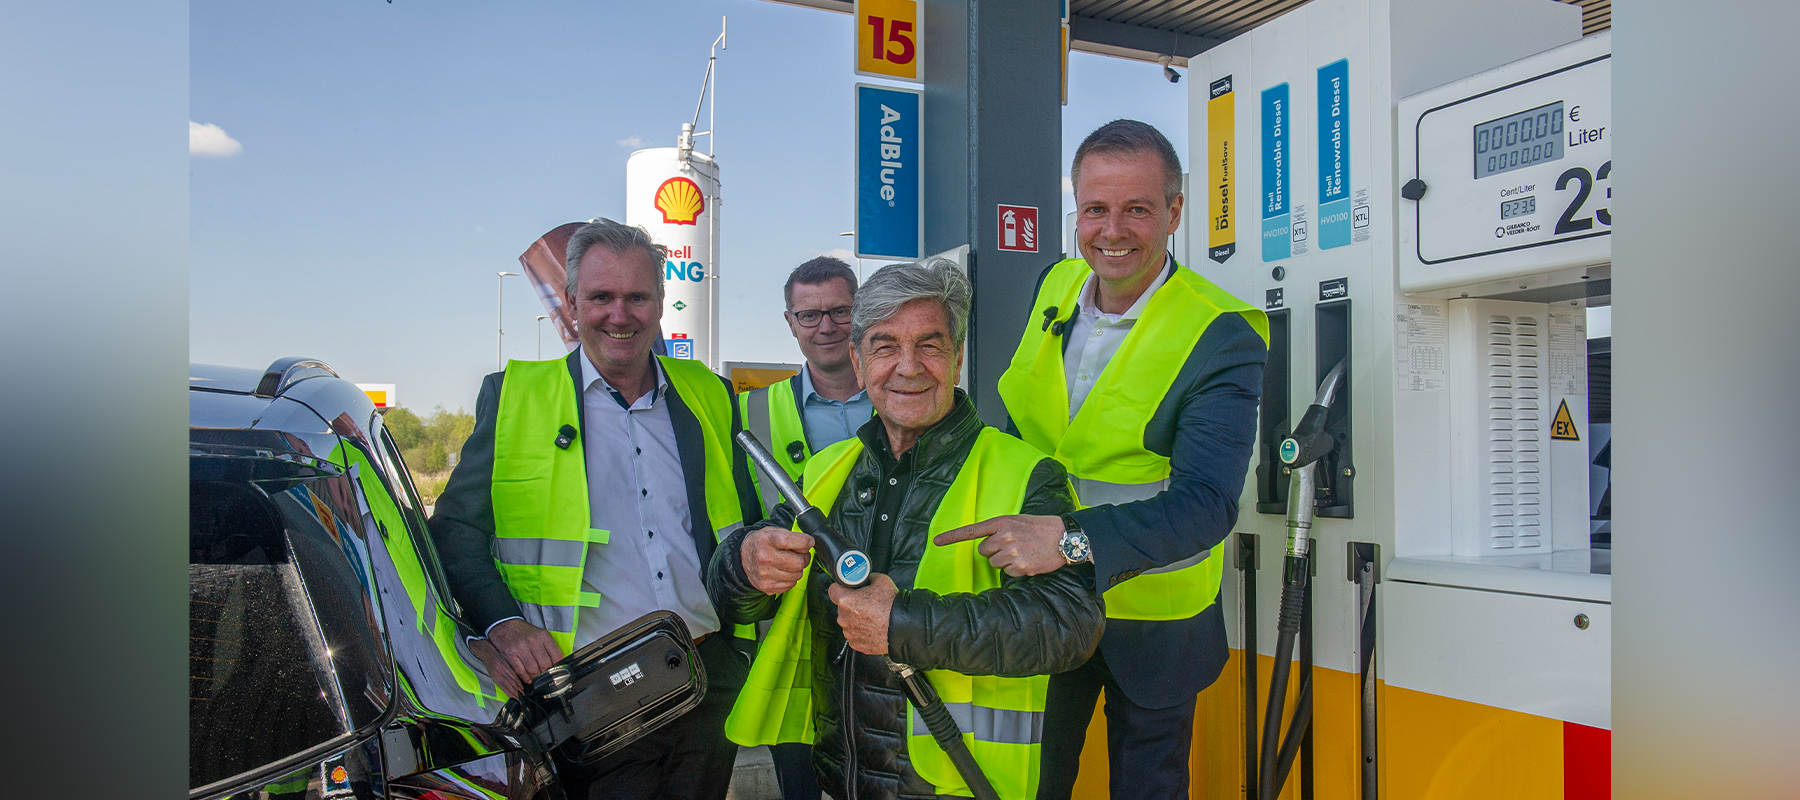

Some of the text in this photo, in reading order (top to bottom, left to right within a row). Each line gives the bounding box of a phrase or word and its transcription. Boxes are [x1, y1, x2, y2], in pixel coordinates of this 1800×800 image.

[868, 15, 915, 65] 15
[1569, 105, 1580, 122] €
[1331, 76, 1342, 195] Renewable Diesel
[1569, 126, 1606, 147] Liter
[1273, 99, 1282, 211] Renewable Diesel
[1500, 184, 1536, 198] Cent/Liter
[1219, 184, 1229, 230] Diesel
[1503, 198, 1536, 218] 223,9
[1320, 211, 1349, 226] HVO100
[1355, 213, 1368, 223] XTL
[1263, 226, 1289, 239] HVO100
[1294, 227, 1306, 236] XTL
[1214, 248, 1230, 258] Diesel
[664, 260, 705, 283] NG
[1556, 421, 1570, 436] EX
